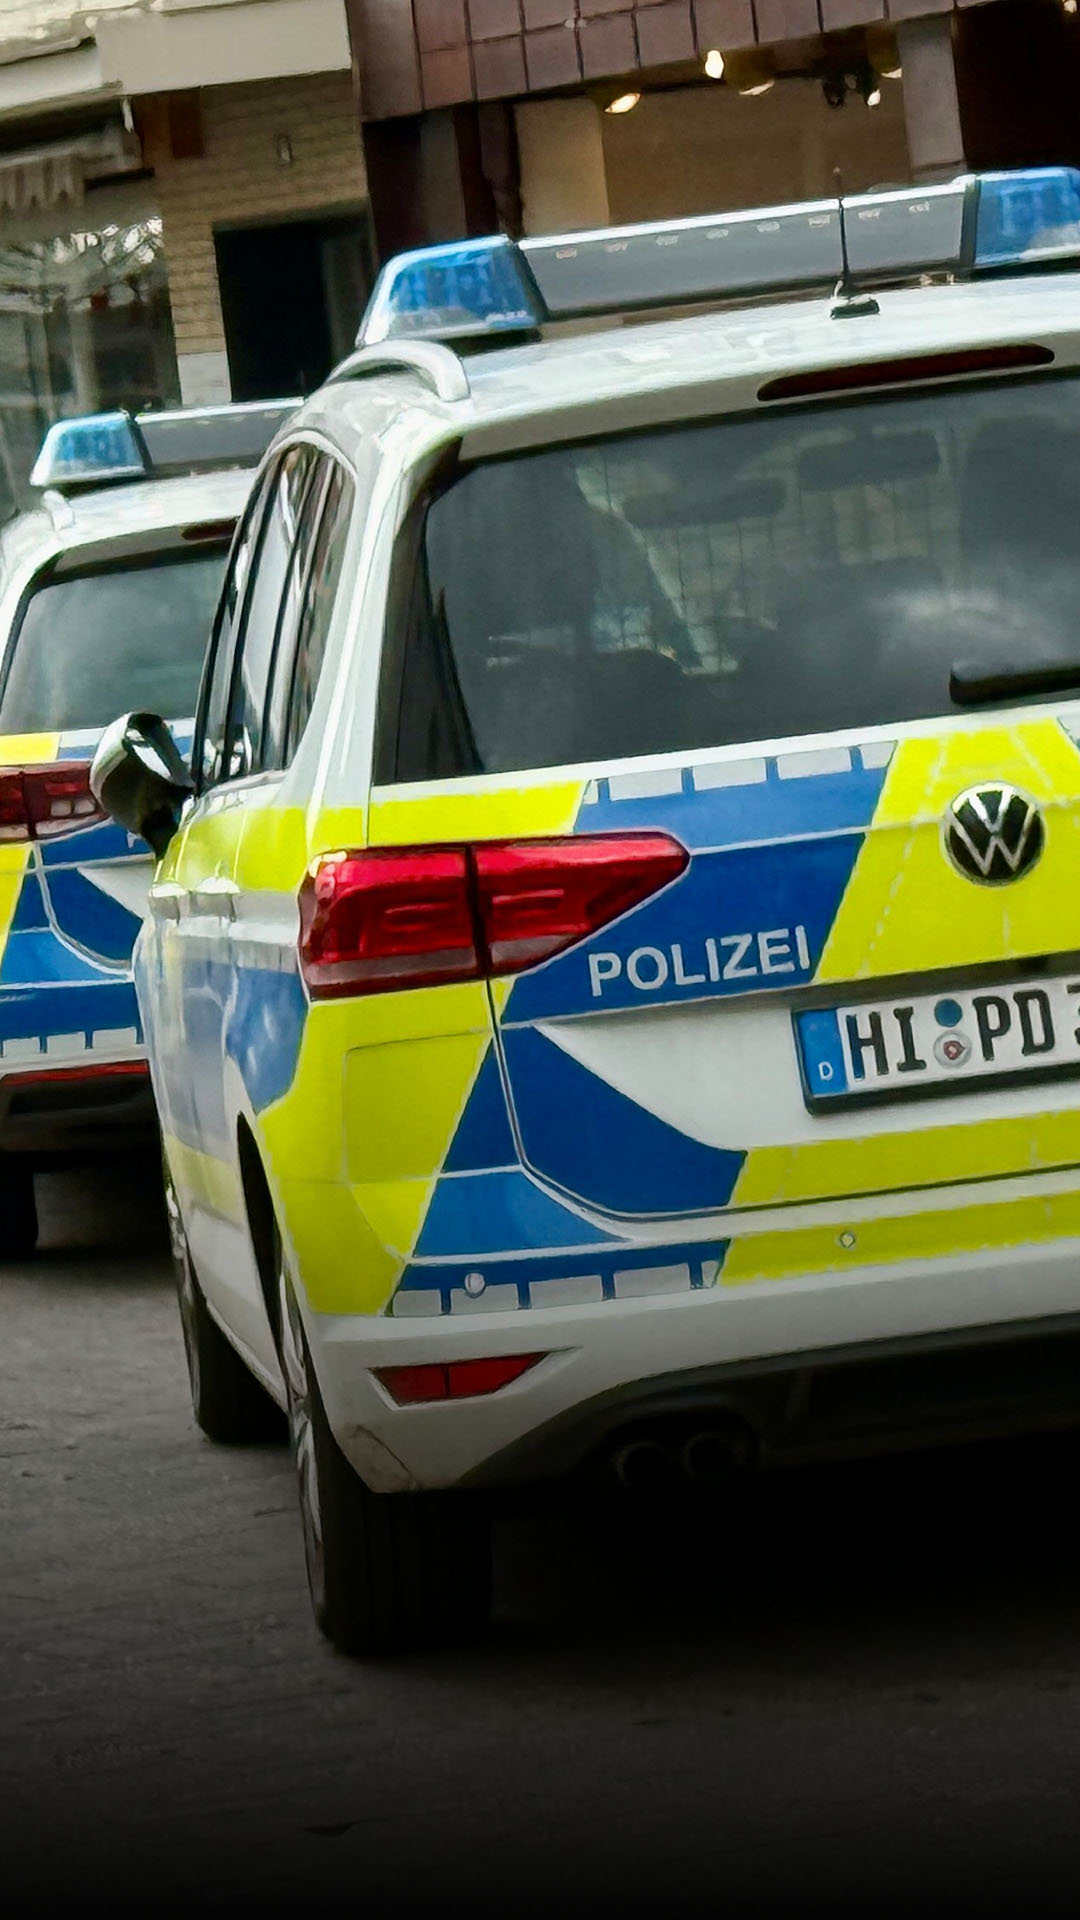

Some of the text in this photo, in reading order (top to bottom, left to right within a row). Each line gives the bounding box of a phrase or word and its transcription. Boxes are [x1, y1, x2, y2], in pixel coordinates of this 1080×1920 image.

[947, 782, 1039, 878] VW
[588, 924, 810, 997] POLIZEI
[818, 1061, 834, 1081] D
[846, 1006, 927, 1081] HI
[972, 988, 1056, 1062] PD
